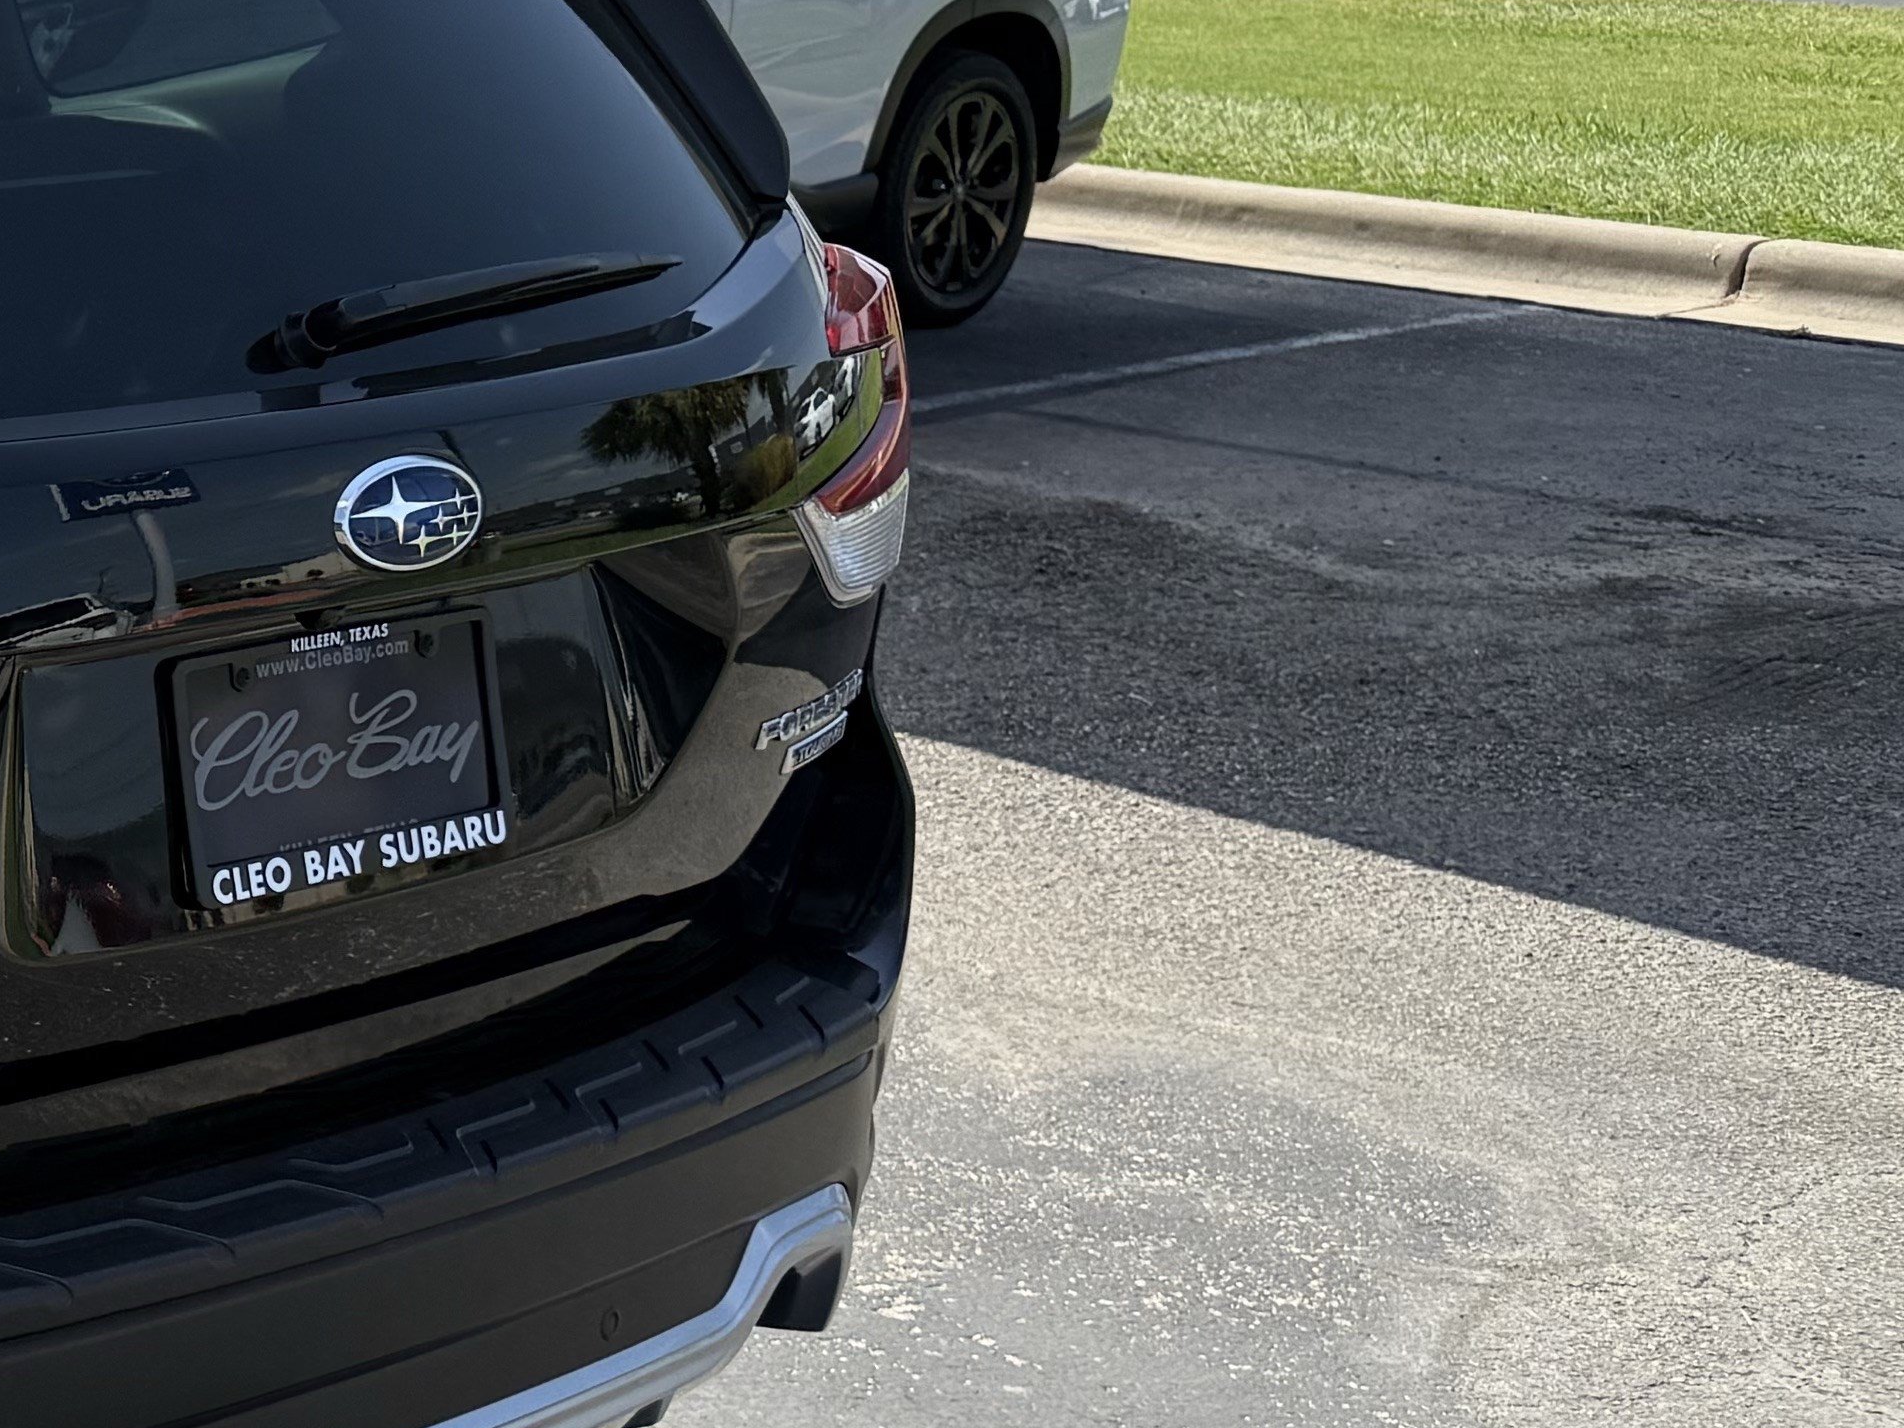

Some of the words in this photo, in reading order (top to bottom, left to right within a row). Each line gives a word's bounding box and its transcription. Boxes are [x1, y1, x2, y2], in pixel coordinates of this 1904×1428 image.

[255, 638, 410, 679] www.CleoBay.com
[291, 630, 346, 653] KILLEEN,
[348, 622, 390, 643] TEXAS
[190, 707, 348, 812] Cleo
[349, 688, 480, 784] Bay
[211, 855, 292, 905] CLEO
[303, 838, 366, 886] BAY
[378, 809, 508, 869] SUBARU
